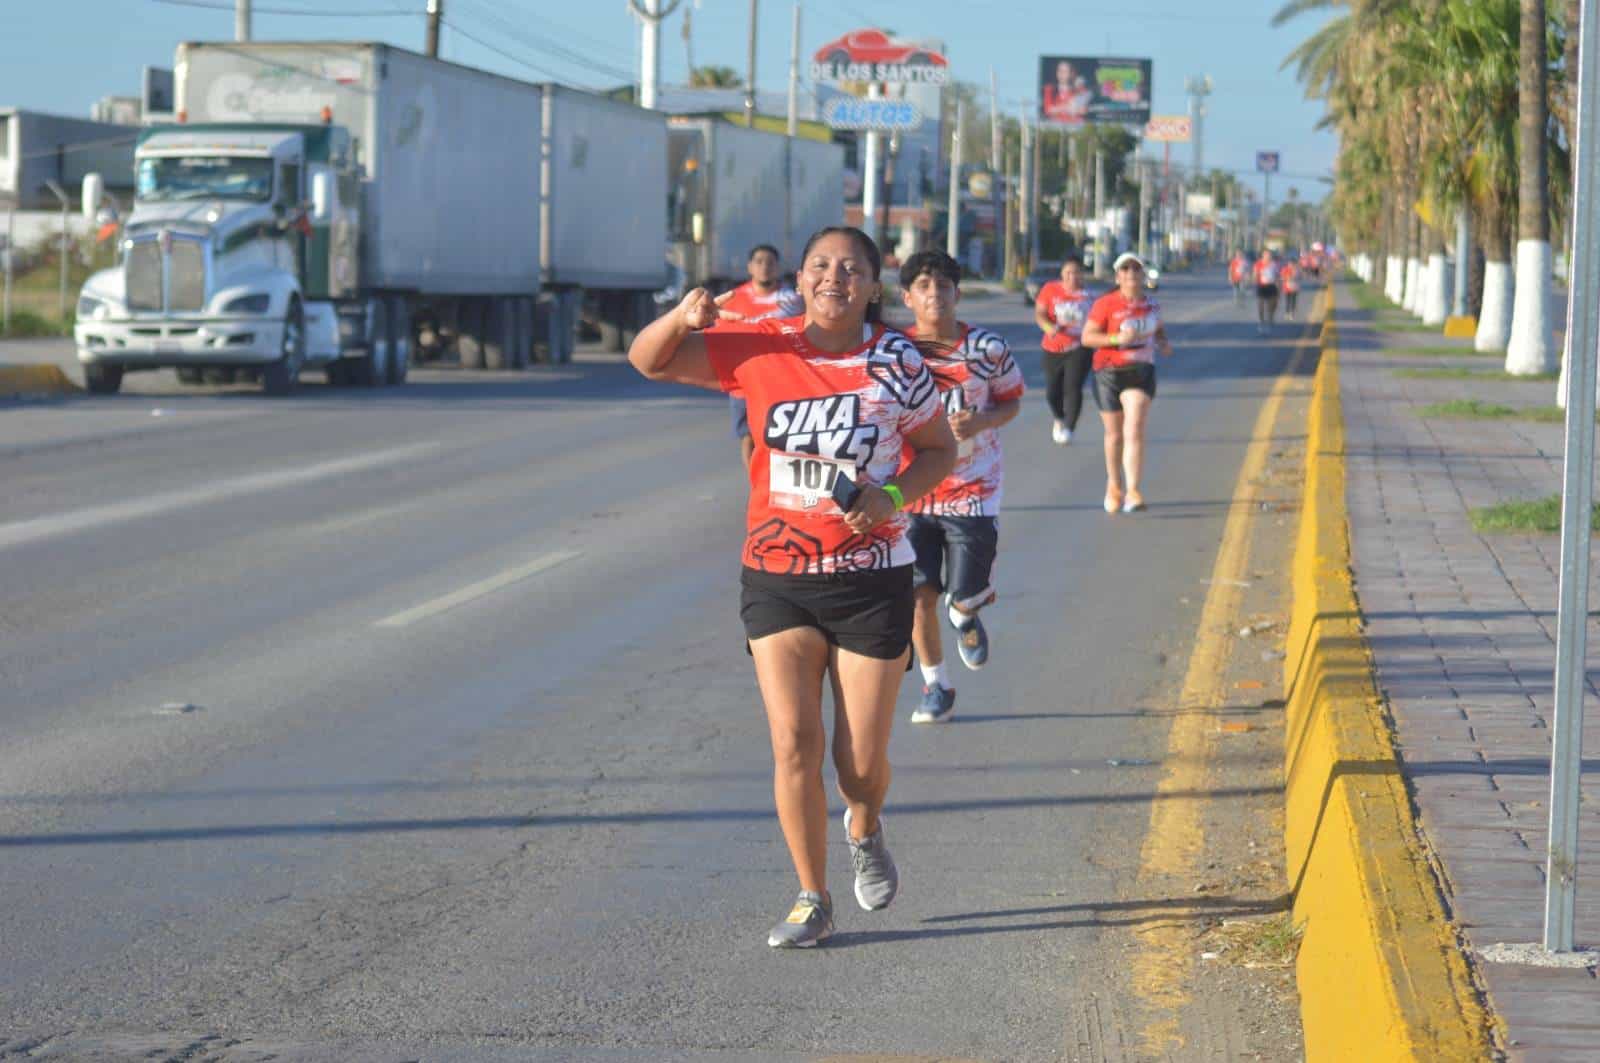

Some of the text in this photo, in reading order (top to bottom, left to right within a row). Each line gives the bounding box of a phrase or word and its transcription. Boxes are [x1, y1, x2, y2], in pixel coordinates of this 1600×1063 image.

[812, 64, 945, 82] DE LOS SANTOS
[834, 103, 911, 125] AUTOS
[770, 395, 854, 438] SIKA
[787, 459, 838, 491] 107
